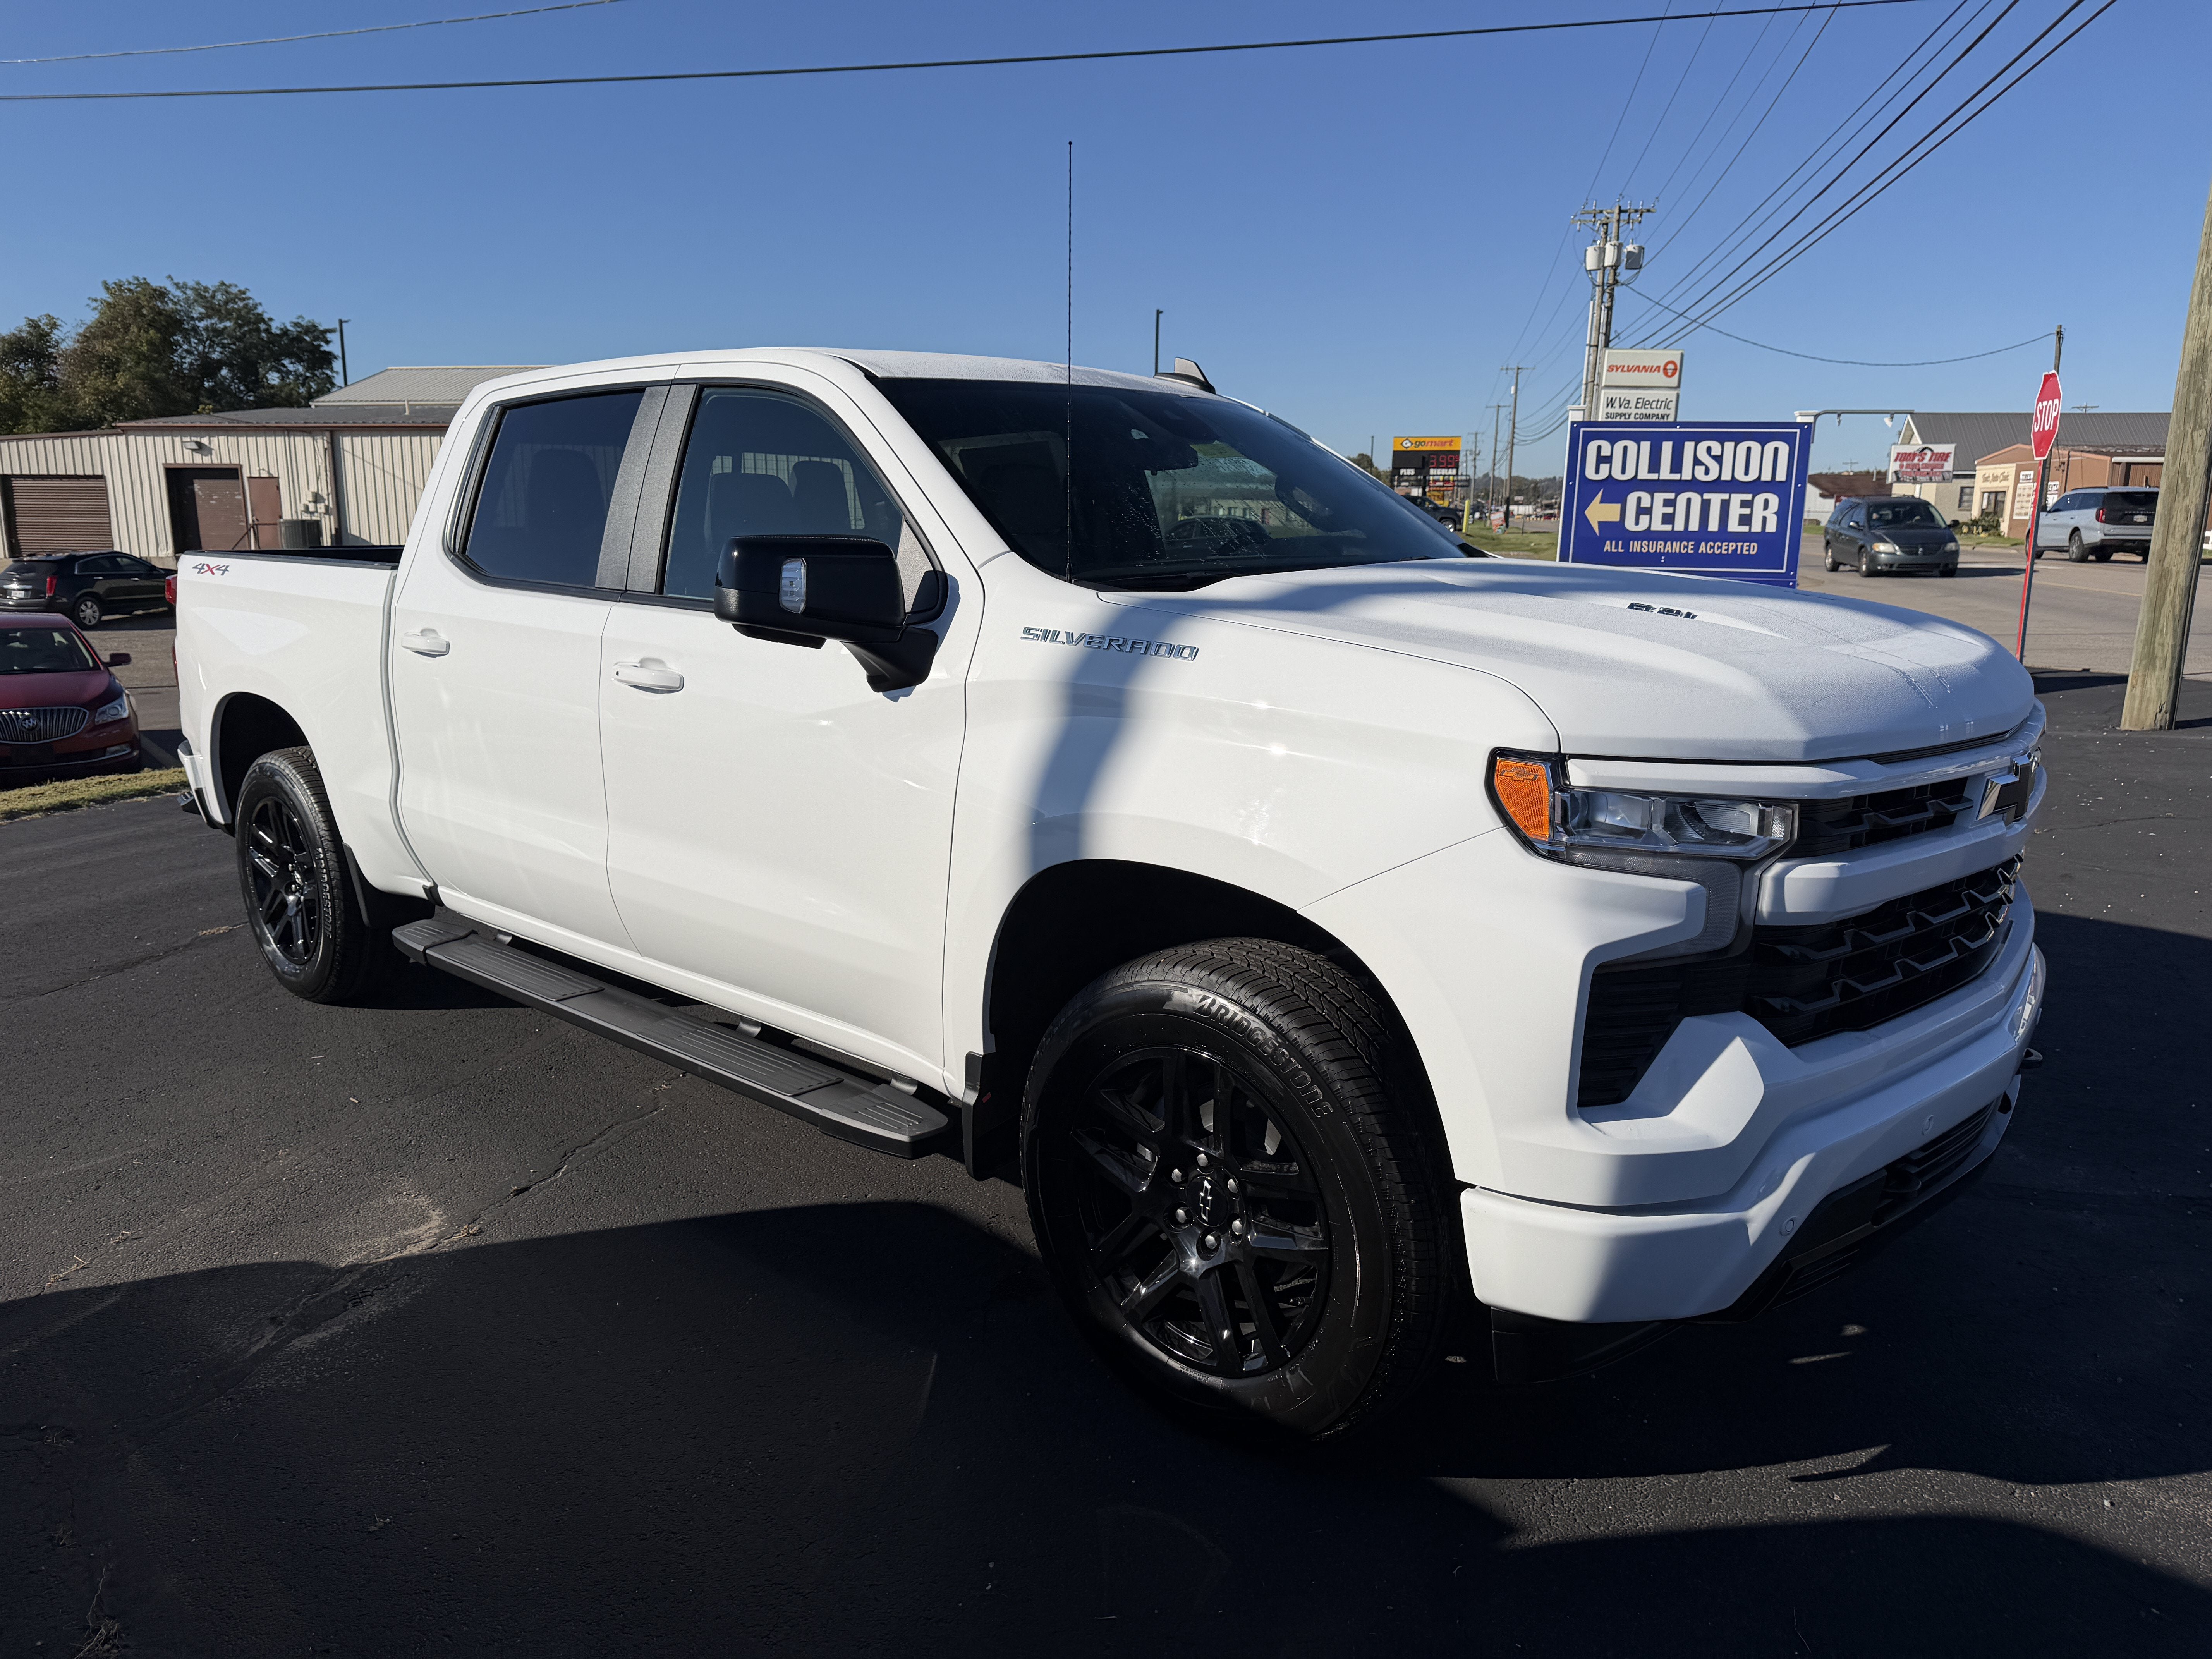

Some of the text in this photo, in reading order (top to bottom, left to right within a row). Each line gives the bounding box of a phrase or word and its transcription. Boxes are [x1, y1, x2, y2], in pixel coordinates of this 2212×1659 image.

[1607, 364, 1661, 373] SYLVANIA
[1635, 397, 1673, 410] Electric
[2034, 398, 2059, 432] STOP
[1585, 440, 1790, 482] COLLISION
[1624, 491, 1779, 533] CENTER
[1604, 540, 1758, 555] ALL INSURANCE ACCEPTED
[1020, 627, 1199, 661] SILVERADO
[1193, 995, 1334, 1118] BRIDGESTONE
